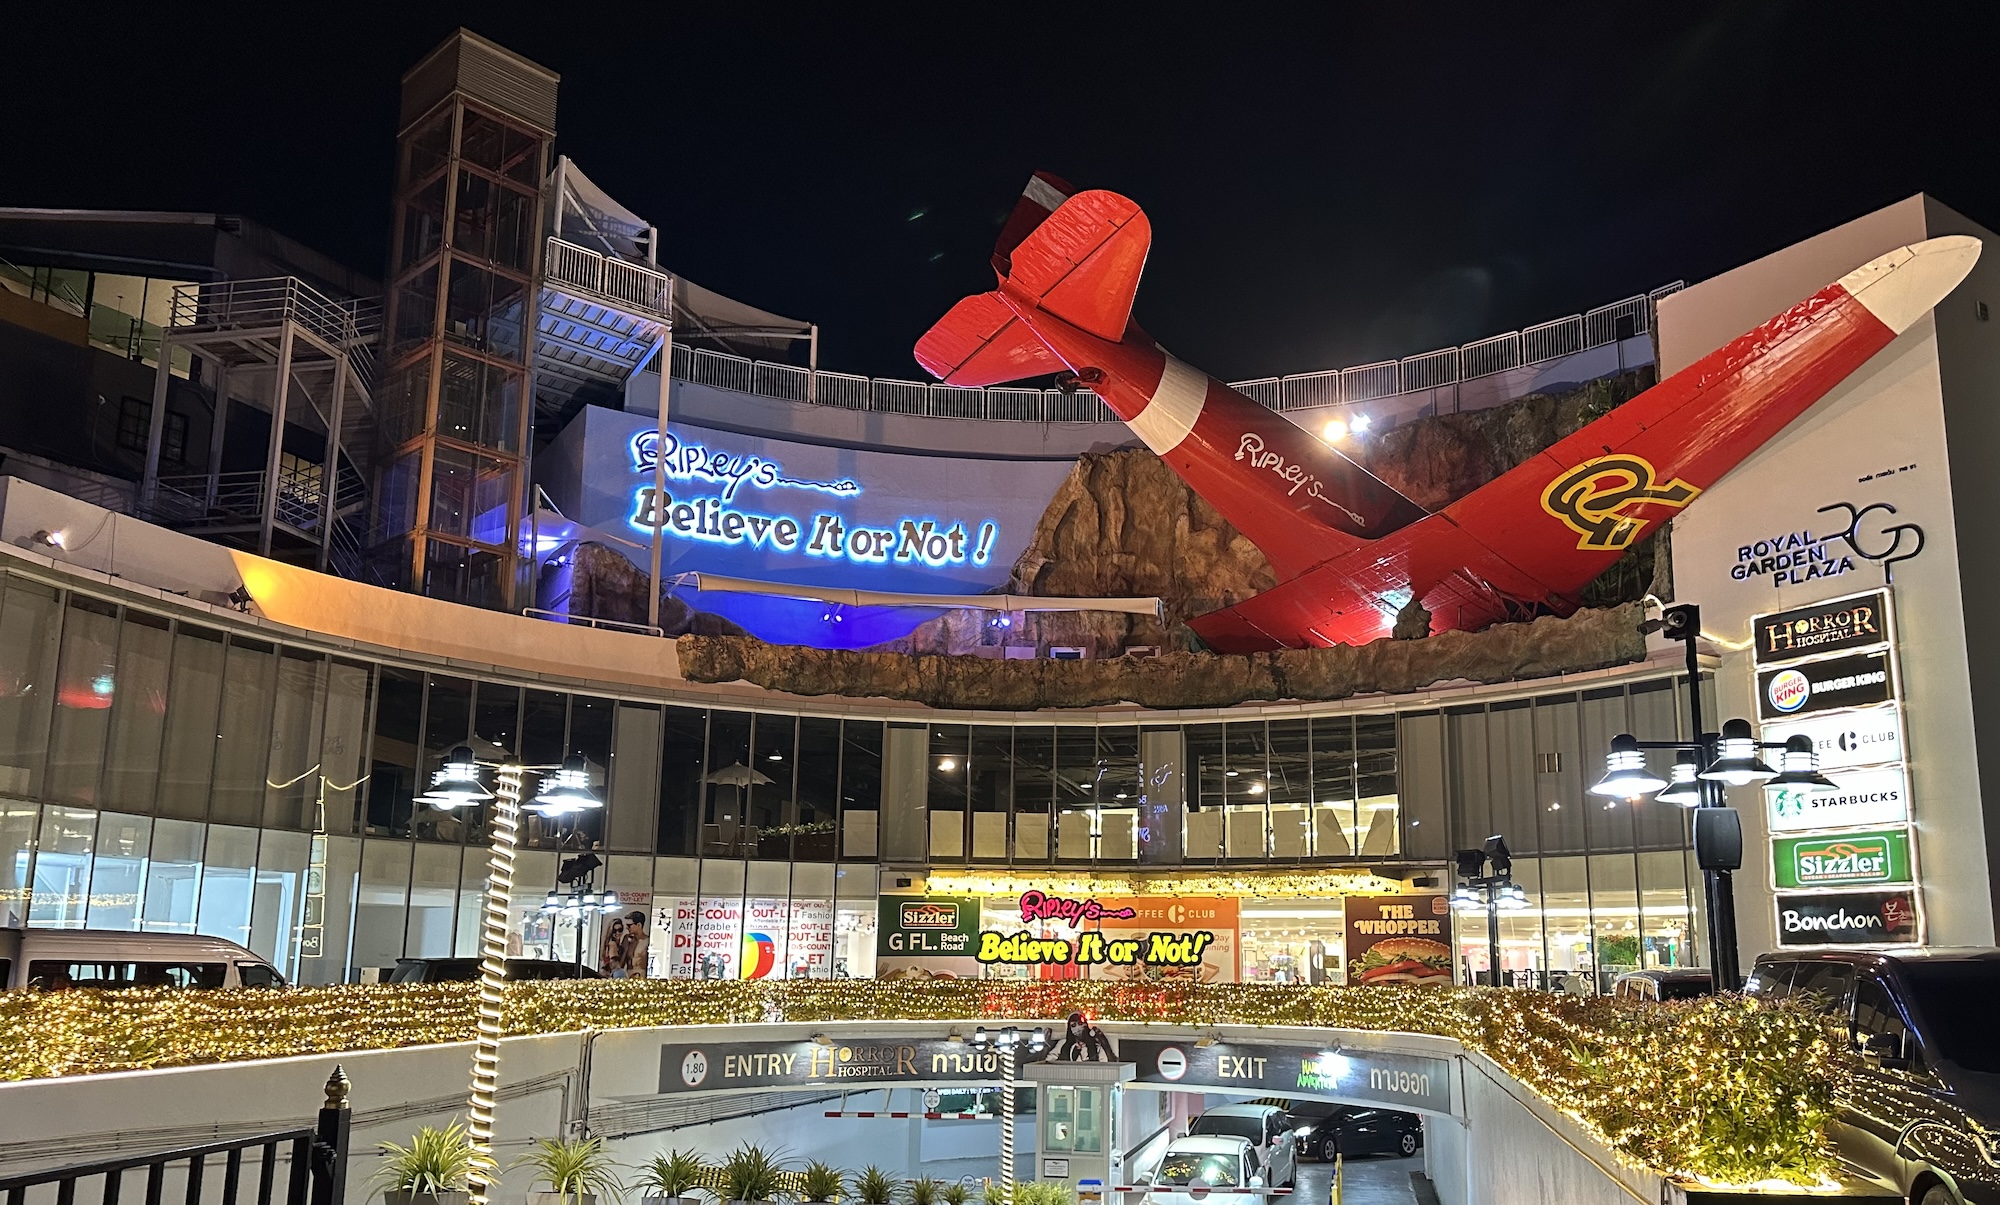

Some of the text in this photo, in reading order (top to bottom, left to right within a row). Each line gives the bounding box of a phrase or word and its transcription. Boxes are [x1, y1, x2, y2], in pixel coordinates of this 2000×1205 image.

[635, 488, 798, 547] Believe
[809, 514, 844, 552] It
[850, 528, 894, 557] or
[1737, 530, 1818, 562] ROYAL
[1730, 545, 1826, 580] GARDEN
[1773, 557, 1856, 588] PLAZA
[1765, 606, 1878, 653] HORROR
[1795, 628, 1852, 648] HOSPITAL
[1773, 676, 1803, 695] BURGER
[1811, 671, 1886, 695] BURGER KING
[1775, 683, 1805, 705] KING
[1862, 731, 1895, 744] CLUB
[1811, 791, 1899, 808] STARBUCKS
[1800, 852, 1885, 876] Sizzler
[677, 909, 744, 919] DiS-COUN
[752, 909, 800, 918] OUT-LT
[903, 911, 956, 924] Sizzler
[1138, 909, 1216, 918] FFEE CLUB
[1378, 904, 1414, 919] THE
[1782, 908, 1883, 932] Bonchon
[678, 922, 731, 931] Affrdable
[1353, 920, 1441, 935] WHOPPER
[888, 932, 938, 950] G FL.
[941, 933, 969, 942] Beach
[941, 941, 965, 950] Road
[976, 931, 1205, 964] Believe It or Not!
[685, 1062, 705, 1074] 1.80
[724, 1052, 797, 1078] ENTRY
[808, 1045, 919, 1078] HORROR
[837, 1066, 893, 1077] HOSPITAL
[1218, 1055, 1268, 1080] EXIT
[1370, 1067, 1430, 1097] ทางออก
